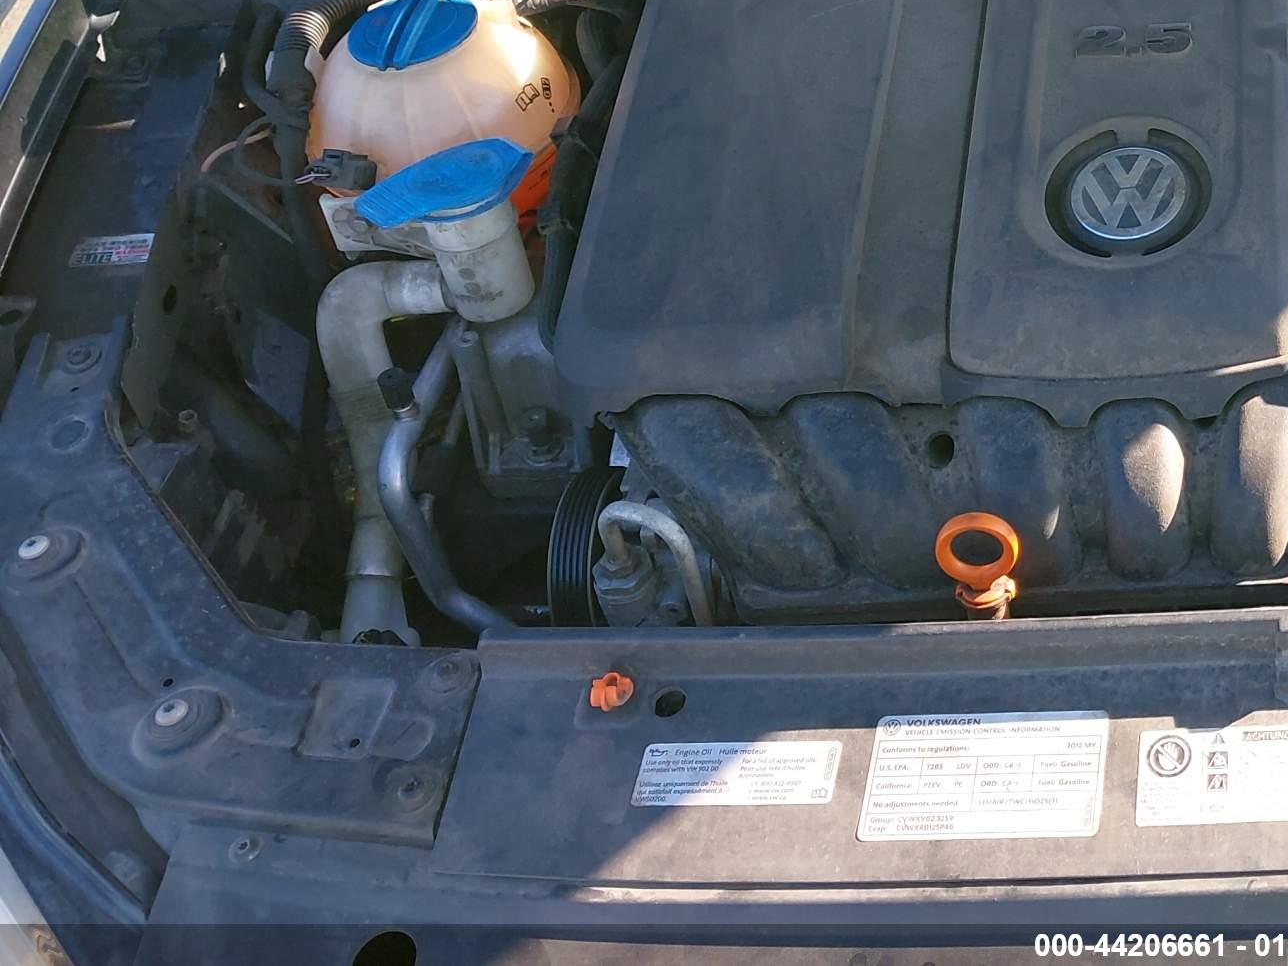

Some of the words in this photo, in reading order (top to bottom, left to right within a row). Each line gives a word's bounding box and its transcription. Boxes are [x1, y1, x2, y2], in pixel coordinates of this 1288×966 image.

[1075, 22, 1193, 58] 2.5
[907, 718, 982, 727] VOLKSWAGEN
[675, 748, 699, 758] Engine
[701, 747, 713, 756] Oil
[718, 747, 739, 756] Huile
[740, 747, 768, 755] moteur
